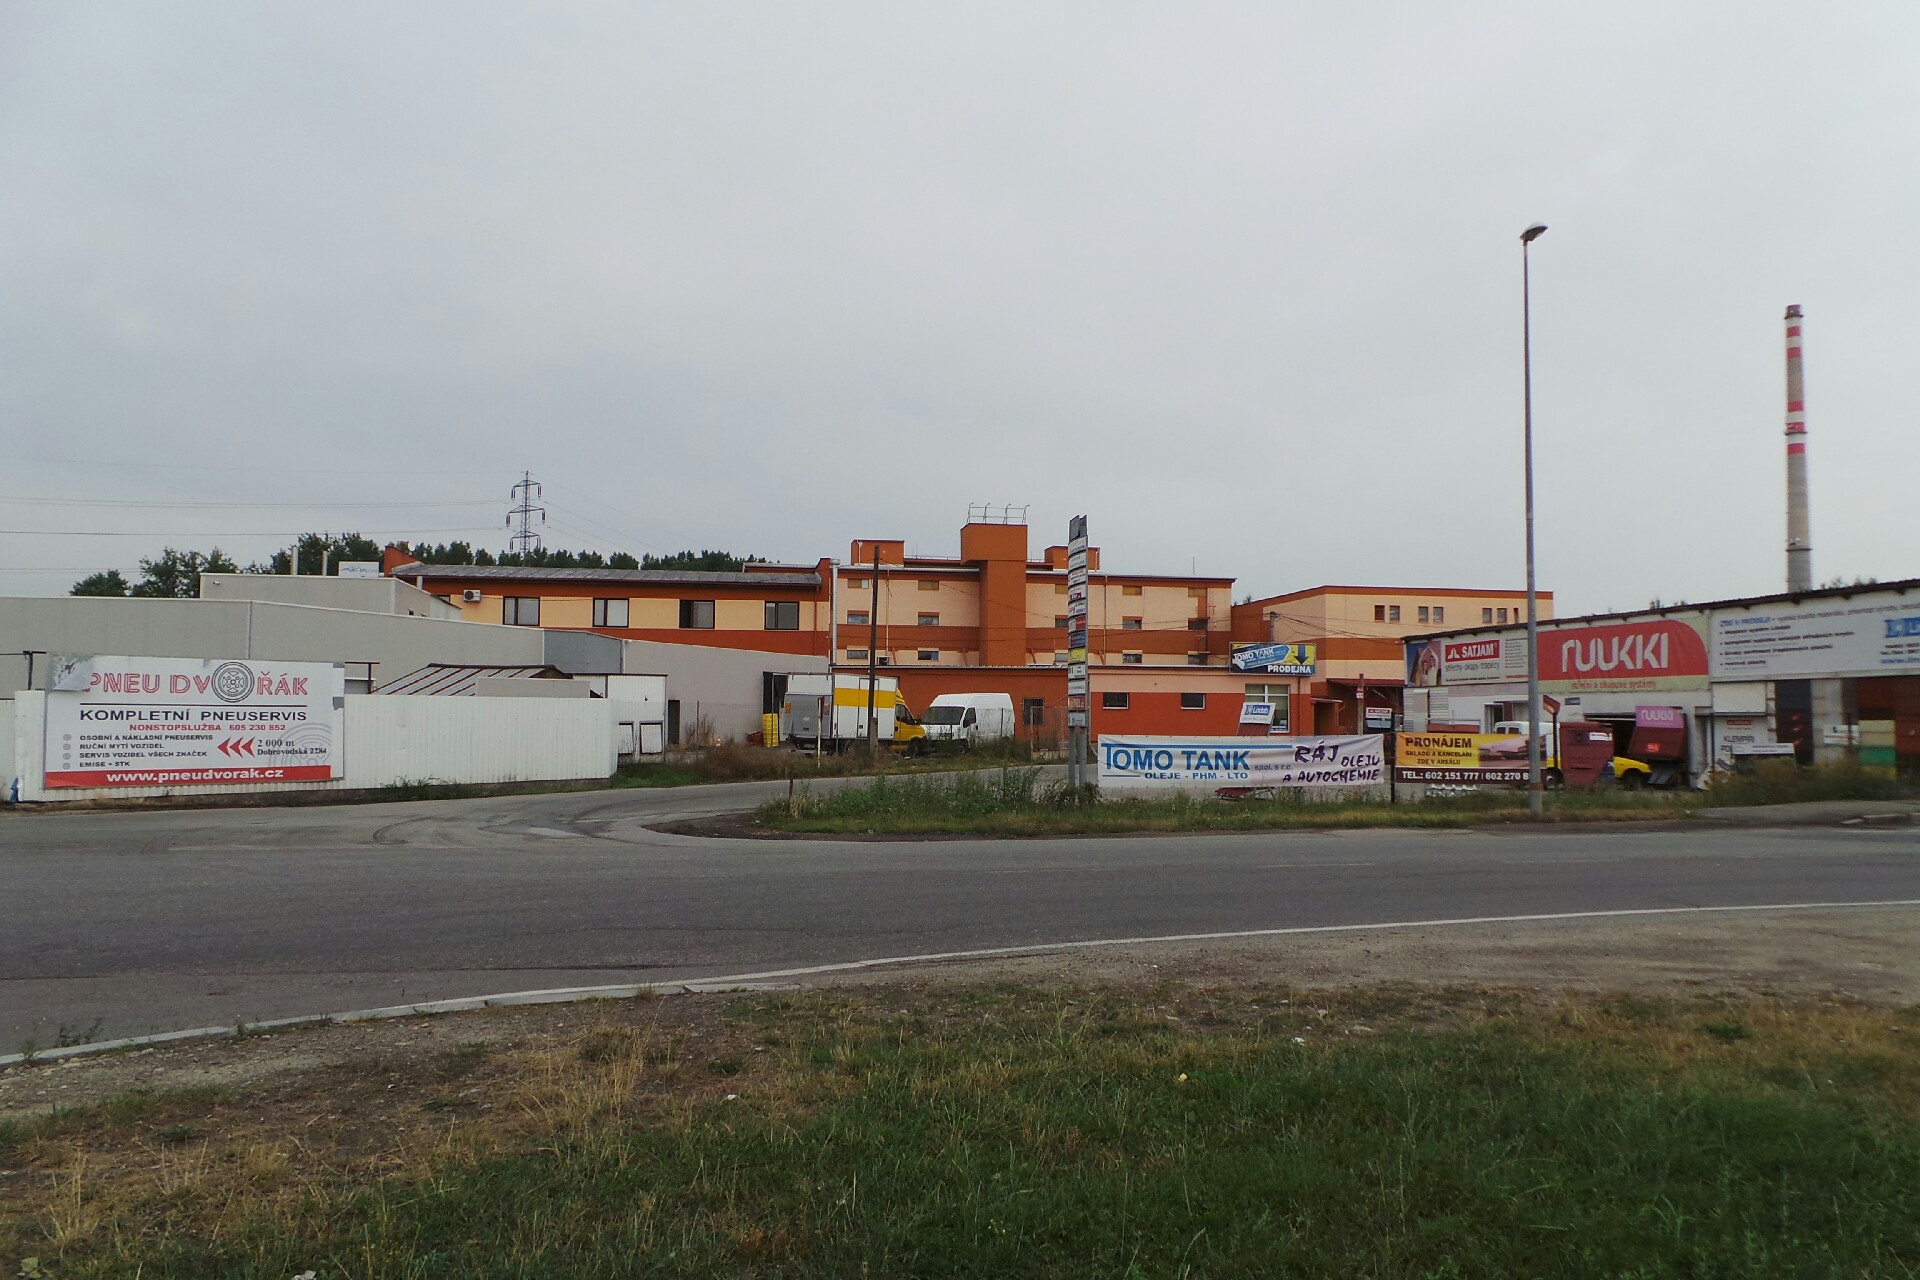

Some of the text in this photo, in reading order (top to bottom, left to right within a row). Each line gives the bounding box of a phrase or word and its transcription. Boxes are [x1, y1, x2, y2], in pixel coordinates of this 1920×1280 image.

[1233, 651, 1254, 662] TOMO
[1255, 647, 1275, 658] TANK
[1461, 643, 1495, 659] SATJAM
[1267, 664, 1312, 674] PRODEJNA
[82, 672, 160, 694] PNEU
[80, 708, 307, 721] KOMPLETNÍ PNEUSERVIS
[129, 723, 222, 732] NONSTOPSLUŽBA
[122, 733, 163, 741] NÁKLADNÍ
[109, 742, 129, 750] MYTÍ
[257, 739, 263, 748] 2
[265, 739, 283, 748] 000
[1405, 735, 1472, 749] PRONÁJEM
[148, 750, 174, 758] VŠECH
[176, 750, 208, 758] ZNAČEK
[257, 747, 308, 756] Dobrovodská
[1294, 740, 1340, 763] RÁJ
[1101, 743, 1250, 771] TOMO TANK
[1437, 757, 1461, 765] AREÁLU
[1254, 763, 1273, 771] spol.
[106, 768, 284, 783] www.pneudvorak.cz
[1144, 772, 1181, 780] OLEJE
[1297, 768, 1380, 784] AUTOCHEMIE
[1402, 771, 1424, 780] TEL.:
[1425, 771, 1443, 780] 602
[1444, 772, 1461, 780] 151
[1463, 772, 1479, 780] 777
[1485, 772, 1502, 780] 602
[1504, 772, 1521, 780] 270
